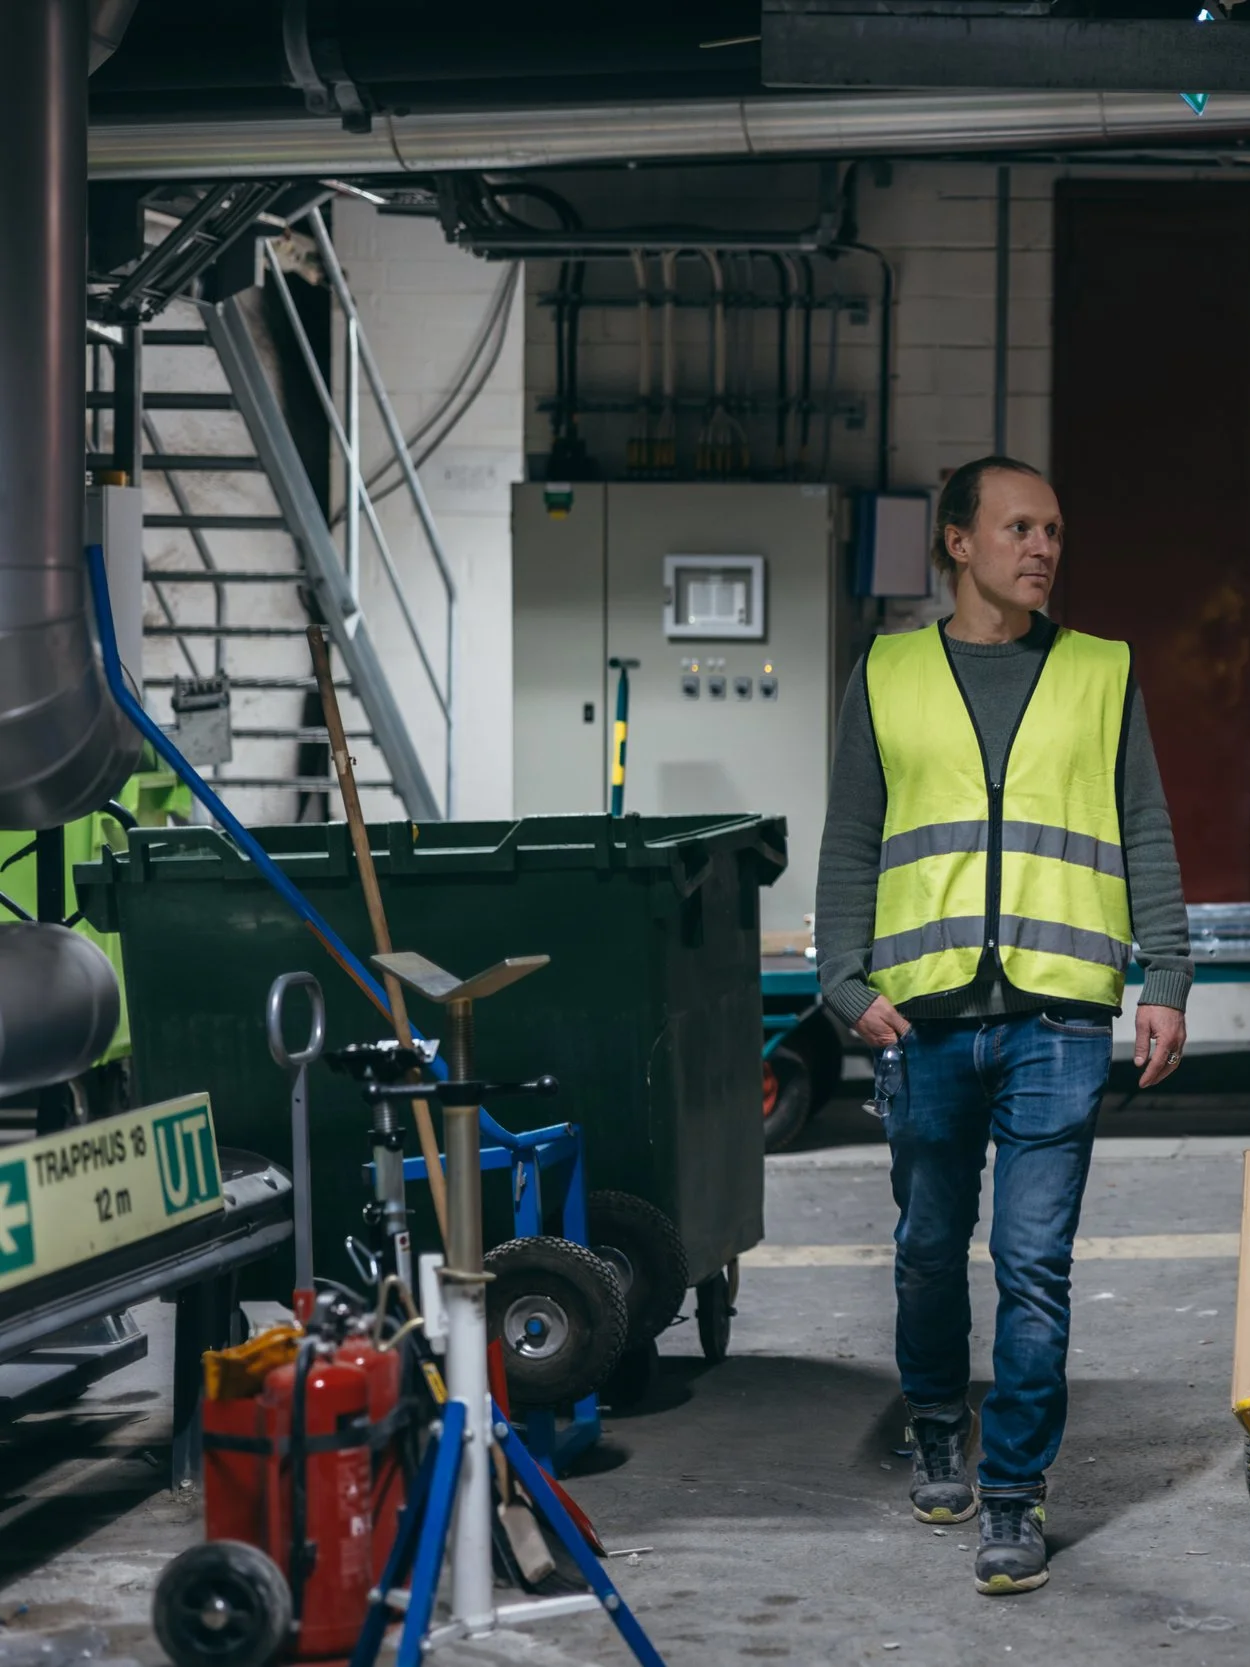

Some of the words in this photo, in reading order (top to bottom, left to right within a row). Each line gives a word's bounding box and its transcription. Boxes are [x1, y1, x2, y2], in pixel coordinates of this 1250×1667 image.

[33, 1129, 127, 1188] TRAPPHUS
[130, 1124, 147, 1159] 18
[156, 1113, 207, 1207] UT
[94, 1187, 113, 1223] 12
[116, 1187, 132, 1216] m
